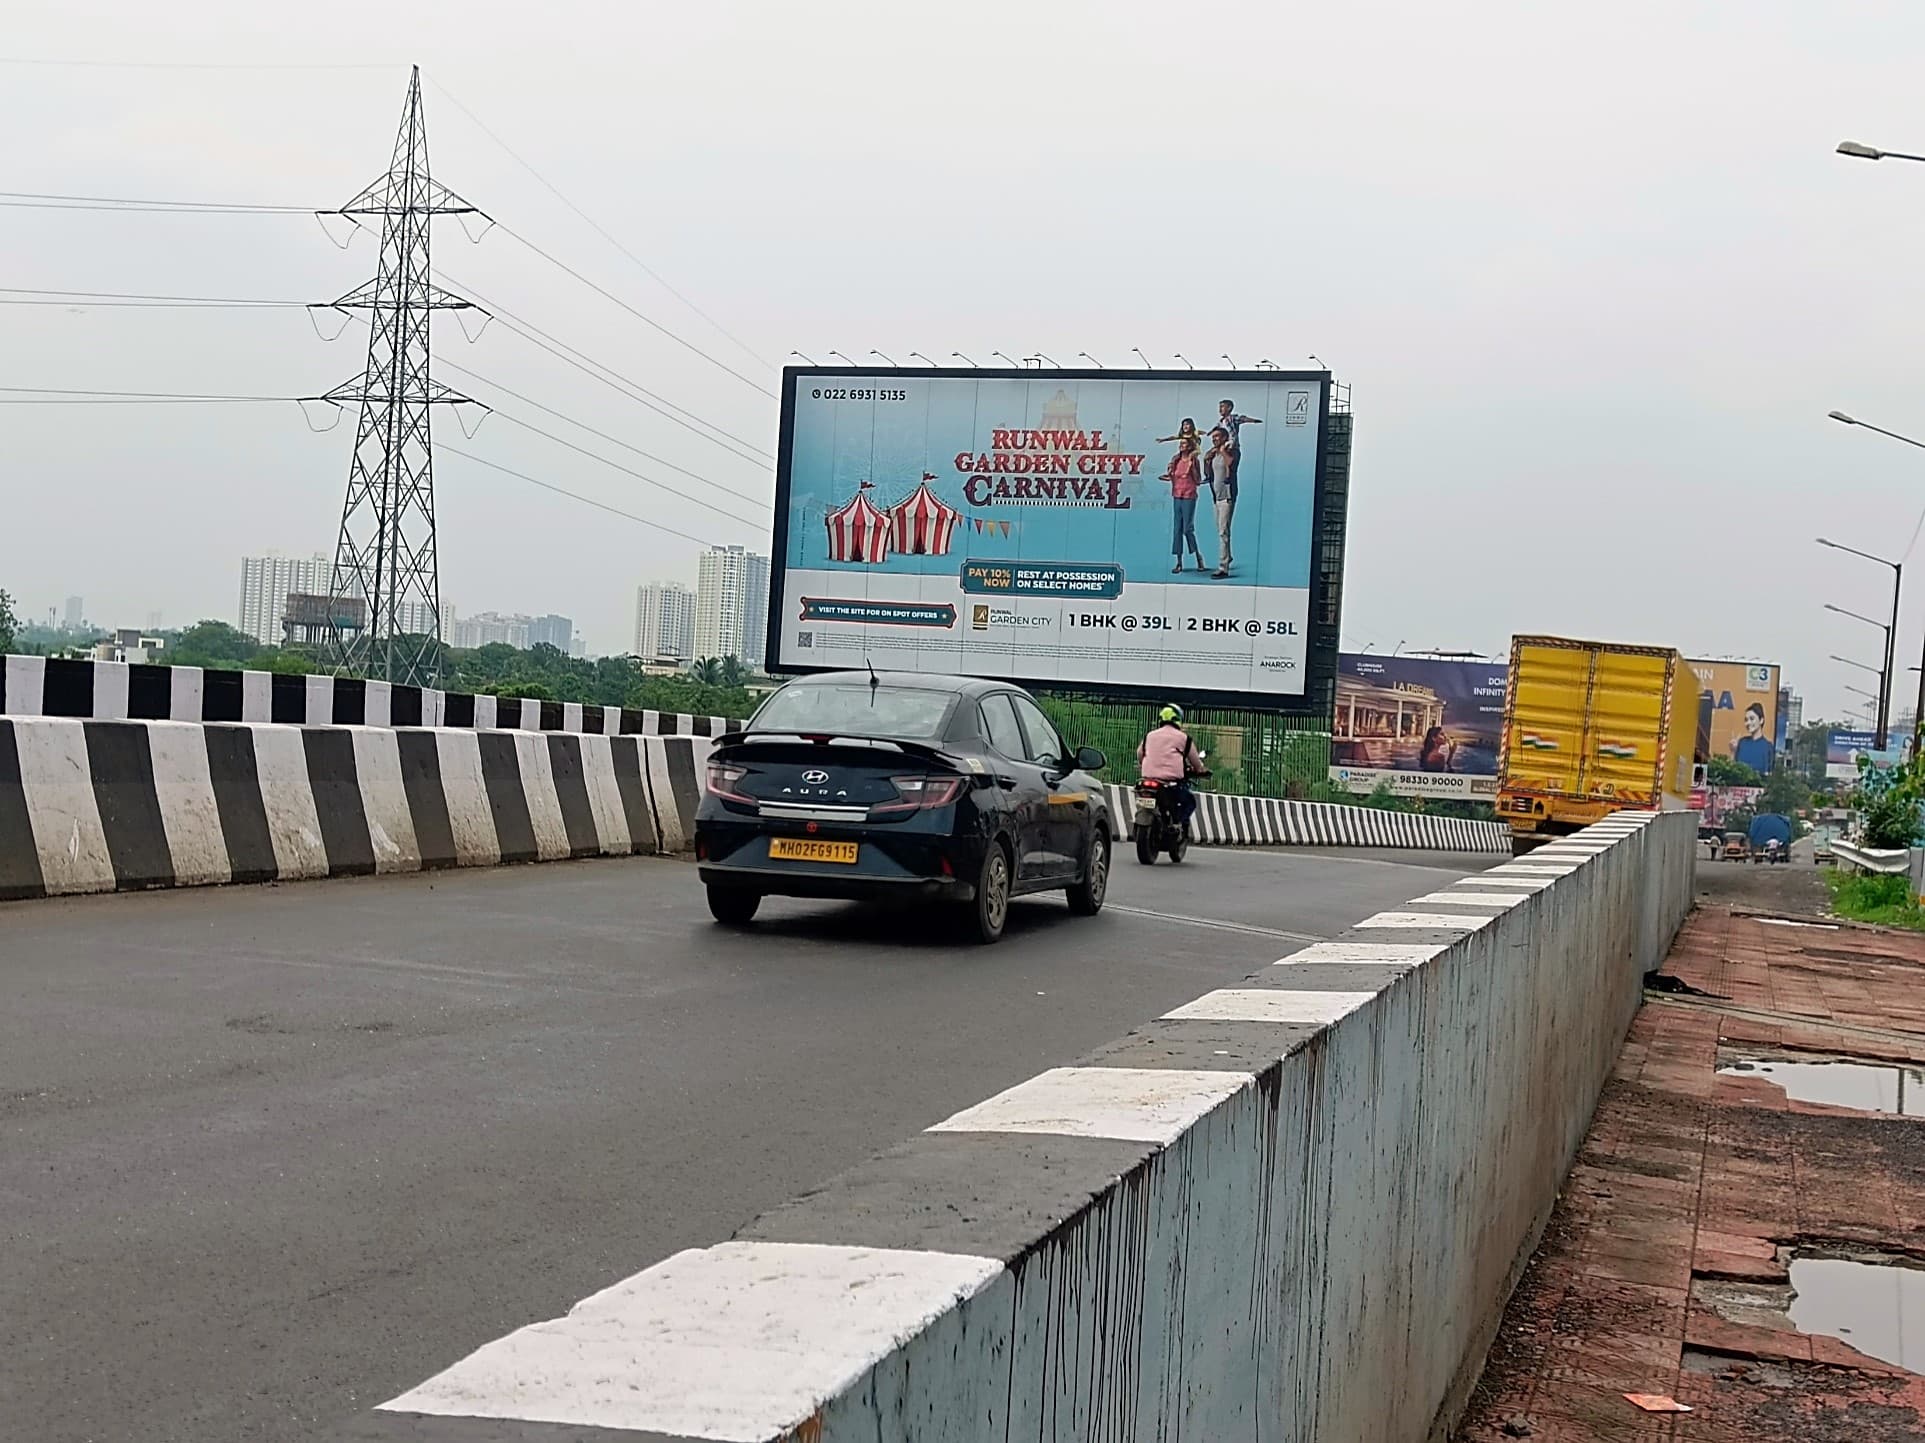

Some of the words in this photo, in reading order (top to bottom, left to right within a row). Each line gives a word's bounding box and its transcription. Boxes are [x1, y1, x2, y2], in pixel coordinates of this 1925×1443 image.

[824, 389, 846, 399] 022
[850, 389, 876, 400] 6931
[880, 390, 906, 401] 5135
[992, 429, 1108, 450] RUNWAL
[954, 452, 1071, 474] GARDEN
[1077, 454, 1145, 475] CITY
[963, 475, 1131, 509] CARNIVAL
[968, 567, 988, 577] PAY
[991, 568, 1011, 578] 10%
[1017, 570, 1040, 579] REST
[1042, 571, 1055, 580] AT
[1056, 572, 1115, 582] POSSESSION
[983, 578, 1011, 588] NOW
[1017, 580, 1031, 588] ON
[1033, 581, 1066, 590] SELECT
[818, 606, 836, 614] VISIT
[893, 610, 910, 618] SPOT
[911, 611, 938, 619] OFFERS
[990, 615, 1030, 625] GARDEN
[1031, 616, 1052, 626] CITY
[1069, 614, 1076, 626] 1
[1080, 614, 1117, 628] BHK
[1121, 615, 1138, 632] @
[1141, 616, 1172, 630] 39L
[1187, 618, 1197, 631] 2
[1202, 618, 1241, 633] BHK
[1244, 620, 1262, 637] @
[1266, 621, 1298, 636] 58L
[1260, 660, 1296, 669] ANAROCK
[1473, 687, 1506, 697] INFINITY
[1400, 775, 1429, 785] 98330
[1431, 777, 1464, 787] 90000
[782, 787, 848, 797] AURA
[779, 840, 856, 860] MH02FG9115
